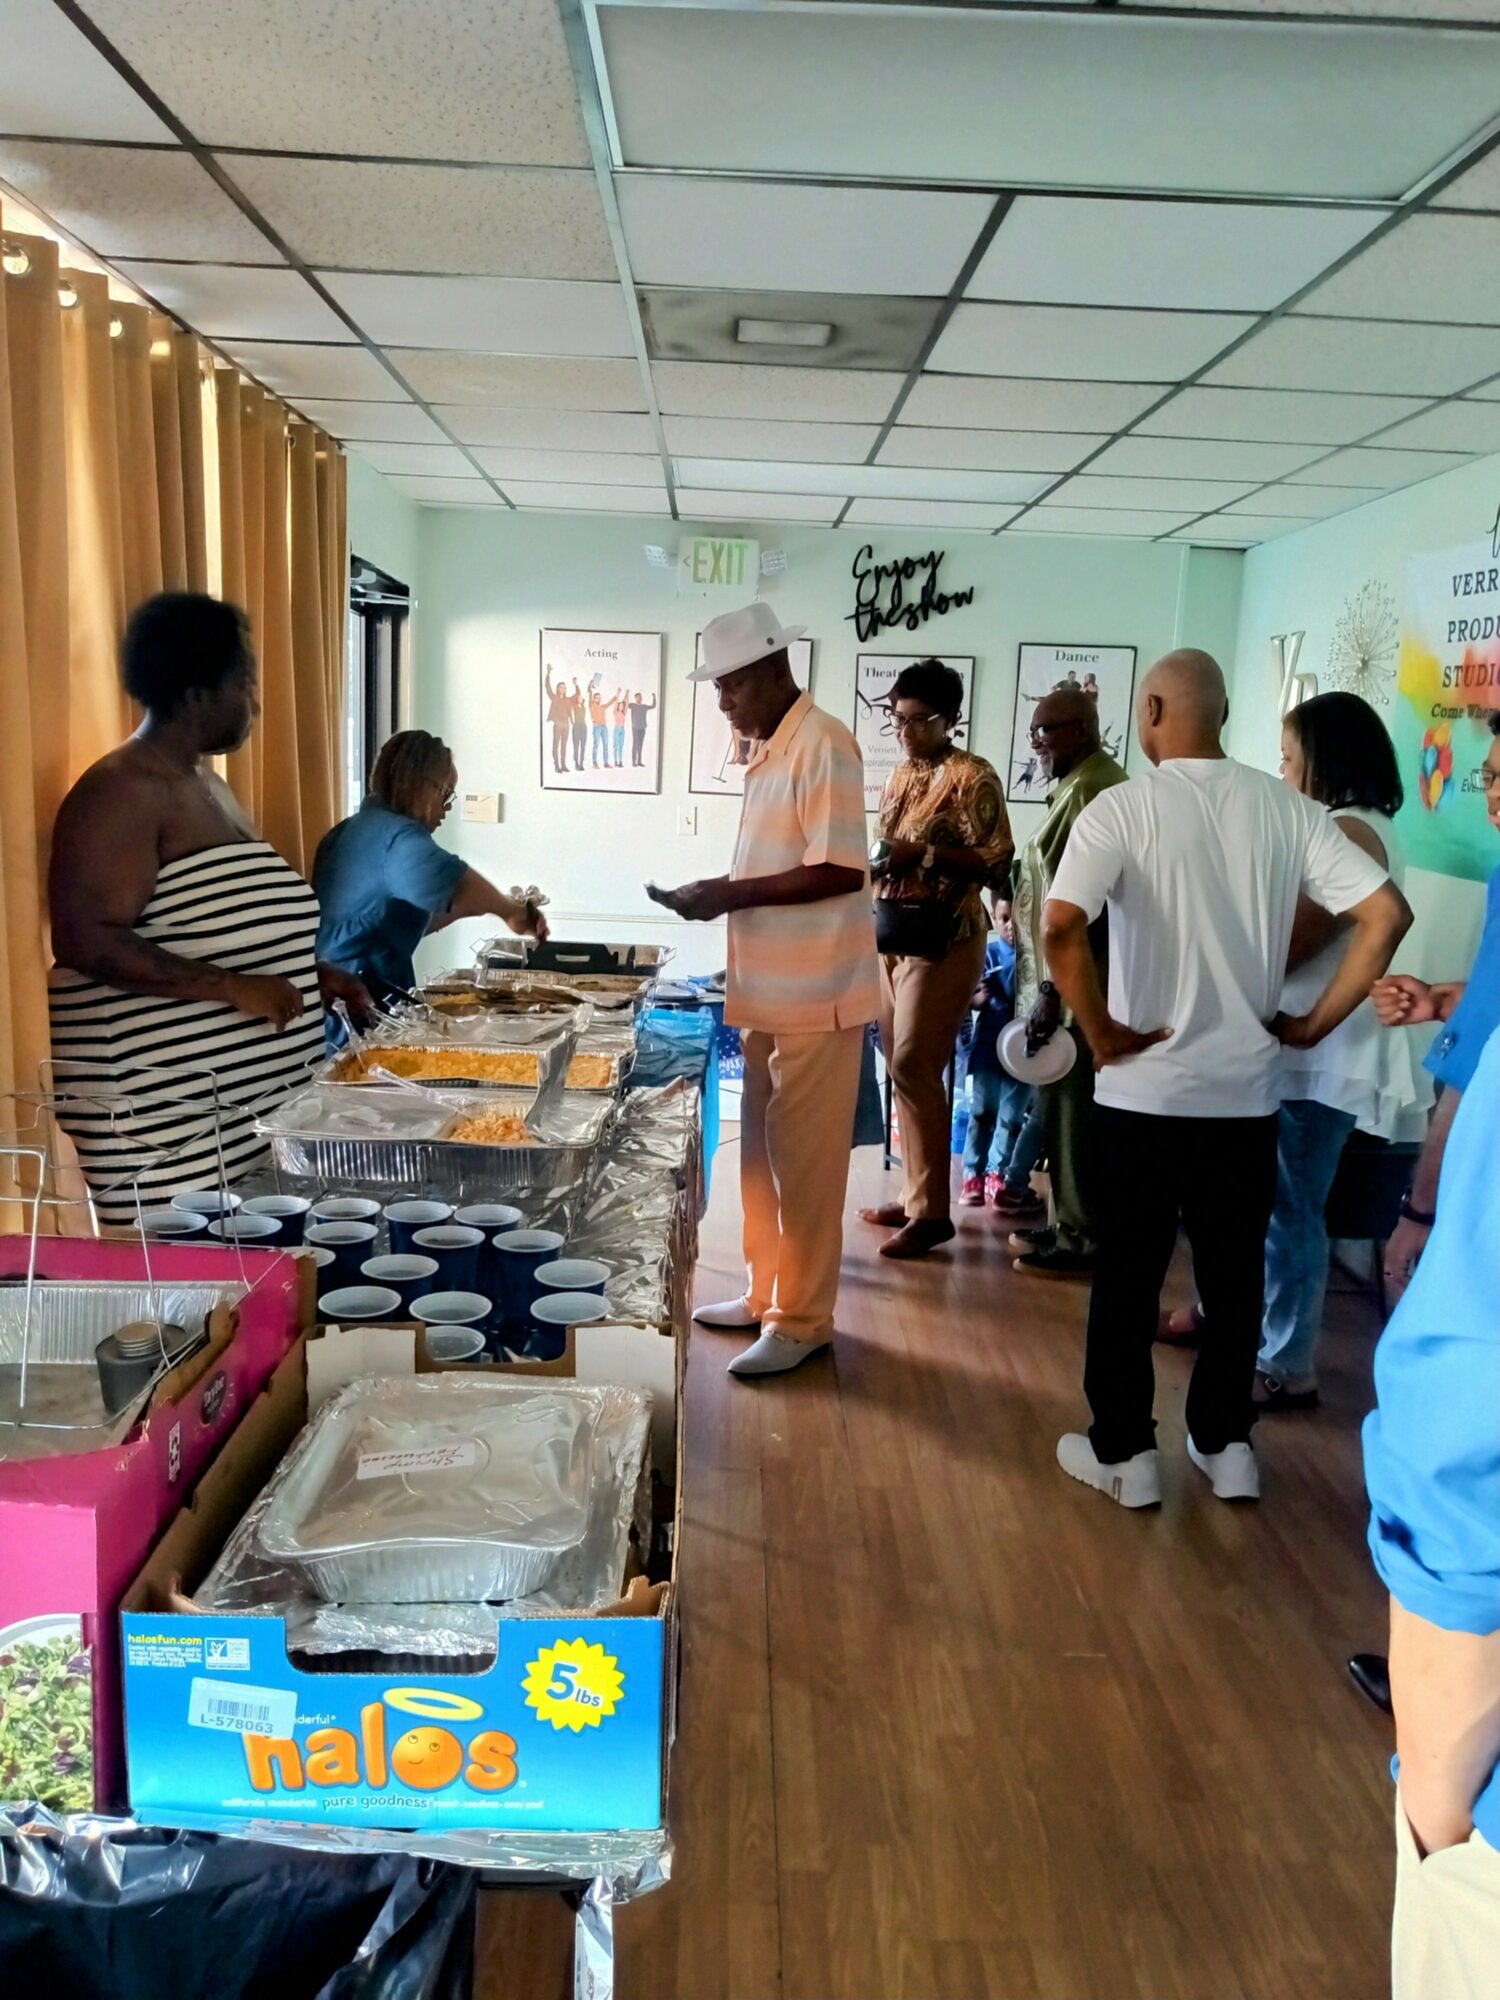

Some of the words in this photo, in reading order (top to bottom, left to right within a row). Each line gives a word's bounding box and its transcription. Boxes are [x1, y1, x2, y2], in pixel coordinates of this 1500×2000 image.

[692, 541, 749, 585] EXIT
[852, 544, 945, 610] Enjoy
[584, 648, 618, 661] Acting
[1055, 650, 1100, 663] Dance
[1431, 703, 1464, 719] Come
[128, 1634, 202, 1645] halosfun.com
[546, 1662, 578, 1700] 5
[575, 1688, 601, 1708] lbs
[200, 1713, 274, 1734] L-578063
[322, 1796, 355, 1811] pure
[360, 1794, 428, 1809] goodness
